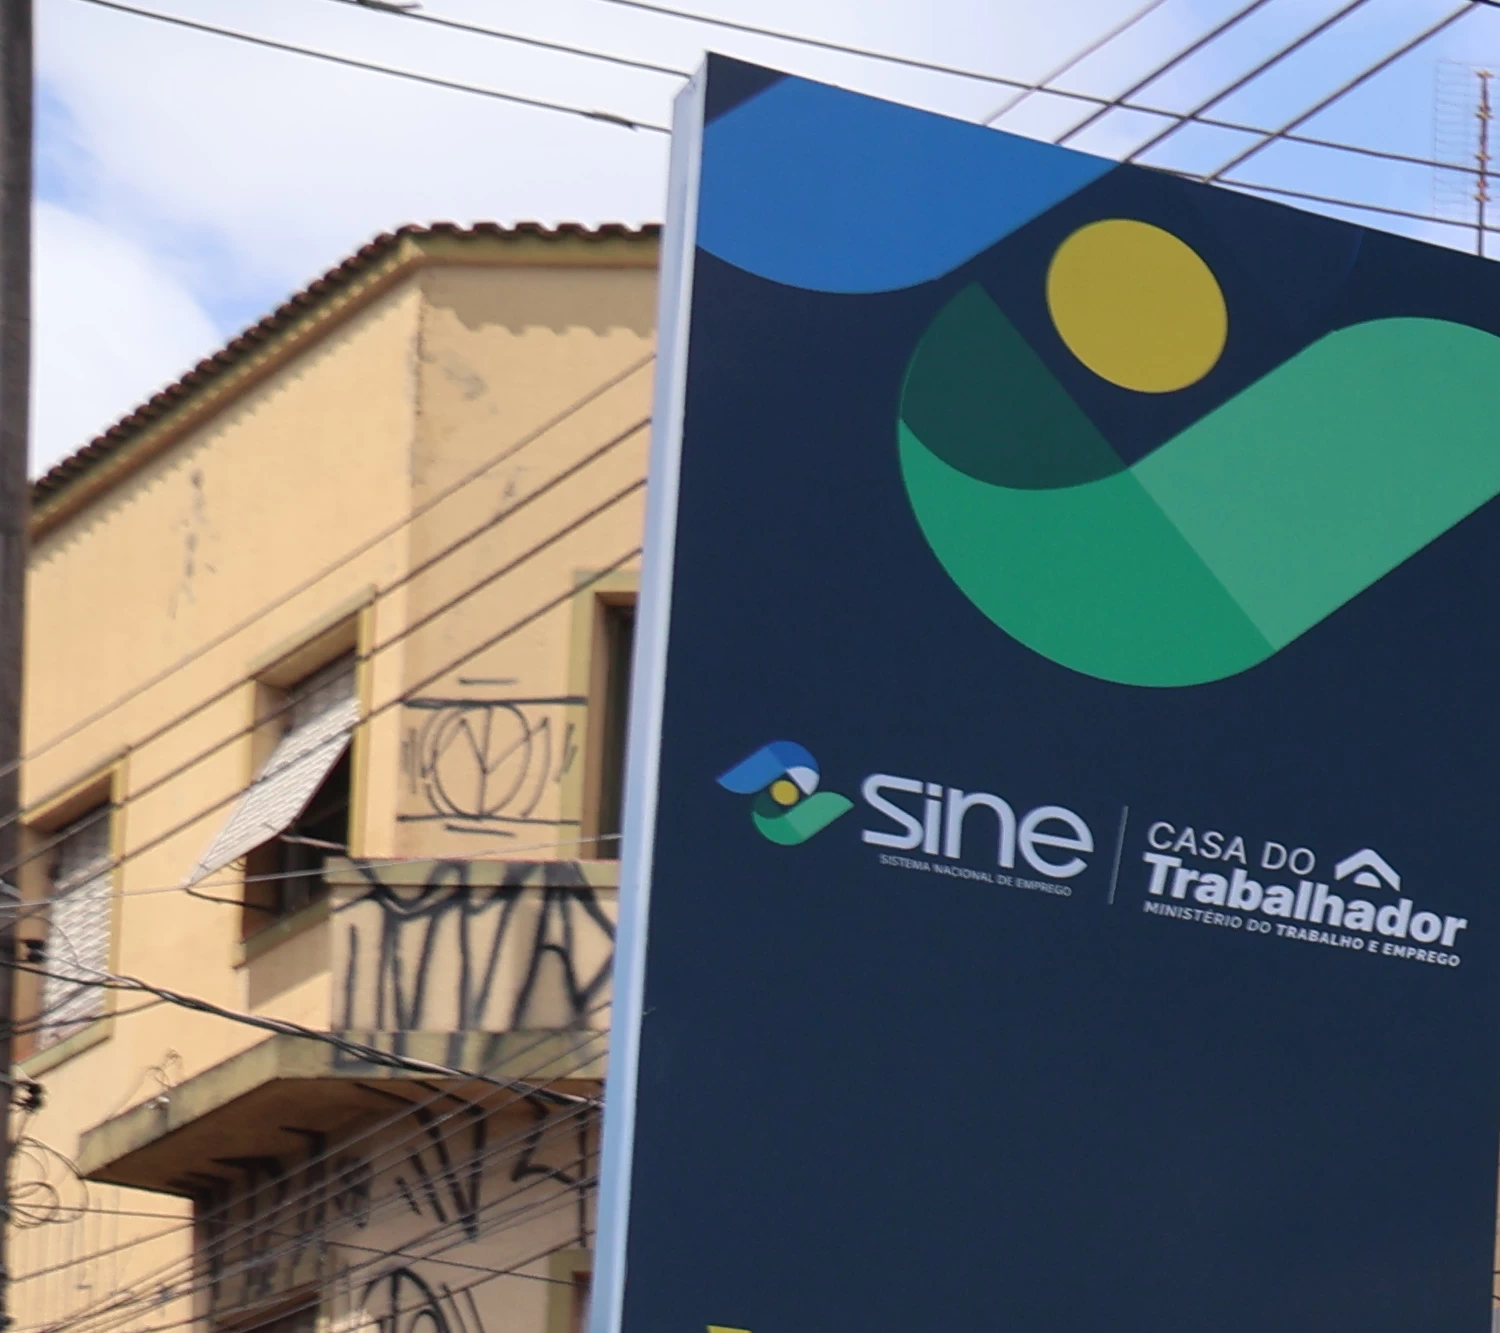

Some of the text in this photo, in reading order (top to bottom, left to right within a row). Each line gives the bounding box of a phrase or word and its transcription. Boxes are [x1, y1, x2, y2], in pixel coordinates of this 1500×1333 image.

[880, 853, 1072, 897] SISTEMA NACIONAL DE EMPREGO
[1147, 821, 1316, 875] CASA DO
[1142, 852, 1468, 947] Trabalhador
[1144, 900, 1461, 967] MINISTÉRIO DO TRABALHO E EMPREGO
